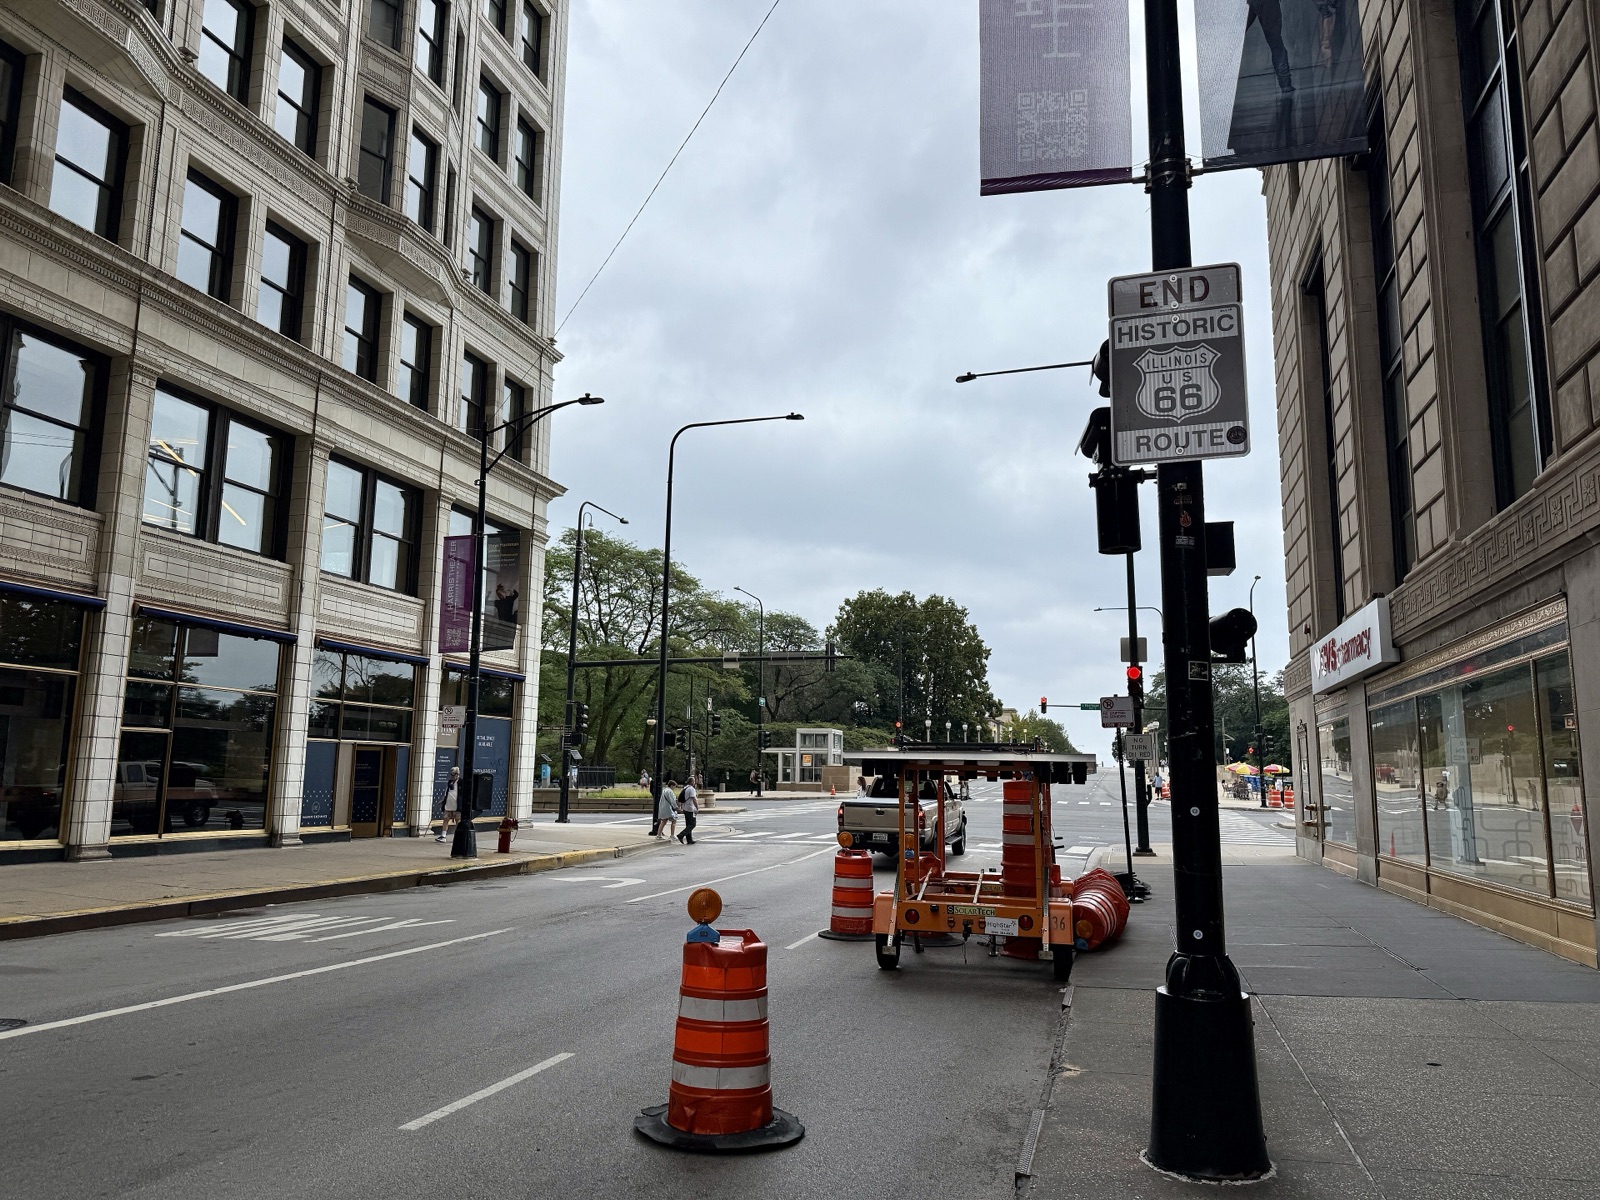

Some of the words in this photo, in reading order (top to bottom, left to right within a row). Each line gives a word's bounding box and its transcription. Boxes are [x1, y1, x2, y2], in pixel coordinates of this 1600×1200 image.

[1139, 275, 1210, 309] END
[1117, 313, 1235, 343] HISTORIC
[1146, 352, 1207, 370] ILLINOIS
[1154, 383, 1203, 413] 66
[1136, 428, 1225, 453] ROUTE
[447, 577, 455, 610] HARRIS
[1320, 637, 1338, 677] CVS
[154, 912, 457, 943] ONLY
[1052, 916, 1066, 931] 36
